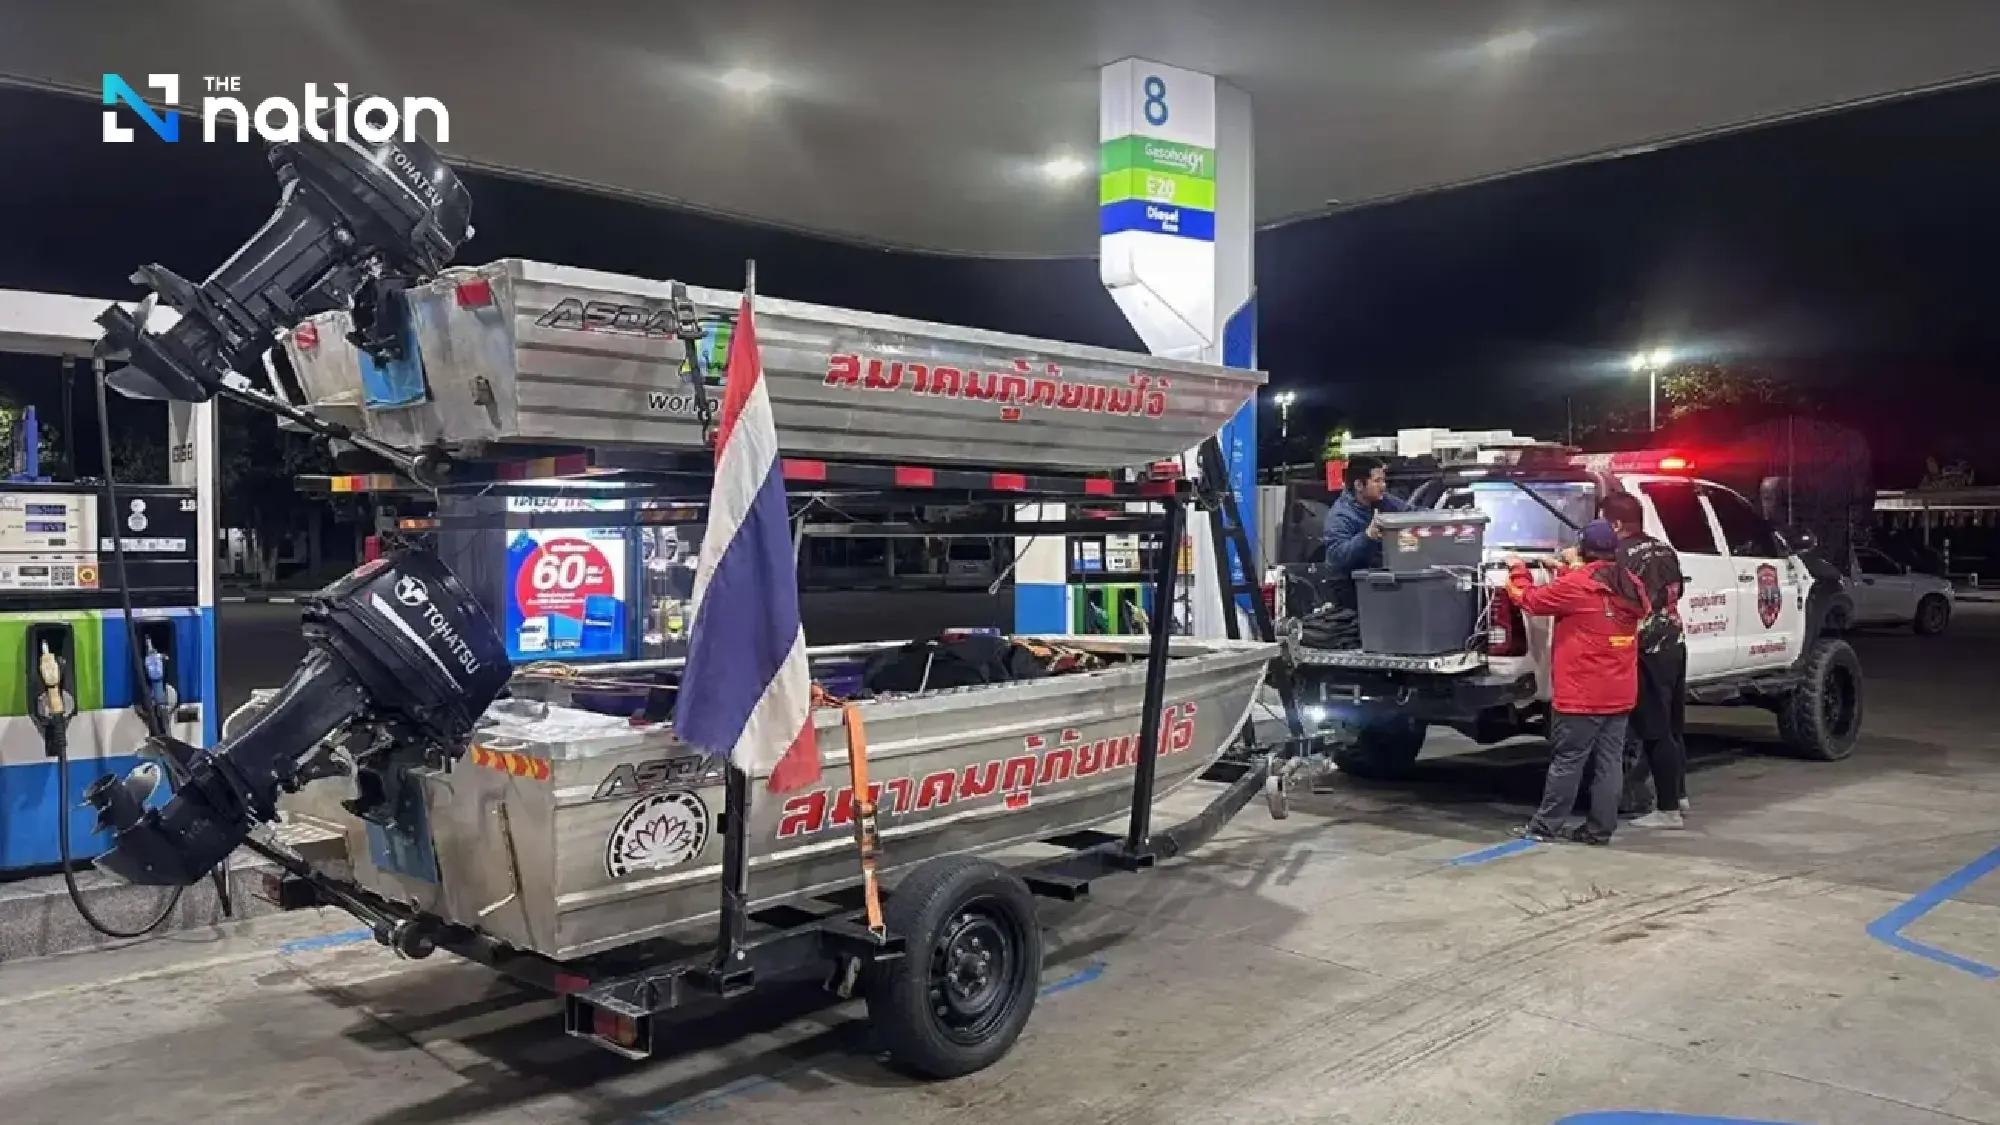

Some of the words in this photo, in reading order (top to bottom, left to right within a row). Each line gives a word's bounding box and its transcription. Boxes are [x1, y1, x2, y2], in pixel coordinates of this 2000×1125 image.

[1144, 75, 1169, 126] 8
[390, 145, 444, 207] TOHATSU
[532, 553, 586, 590] 60
[422, 602, 481, 674] TOHATSU
